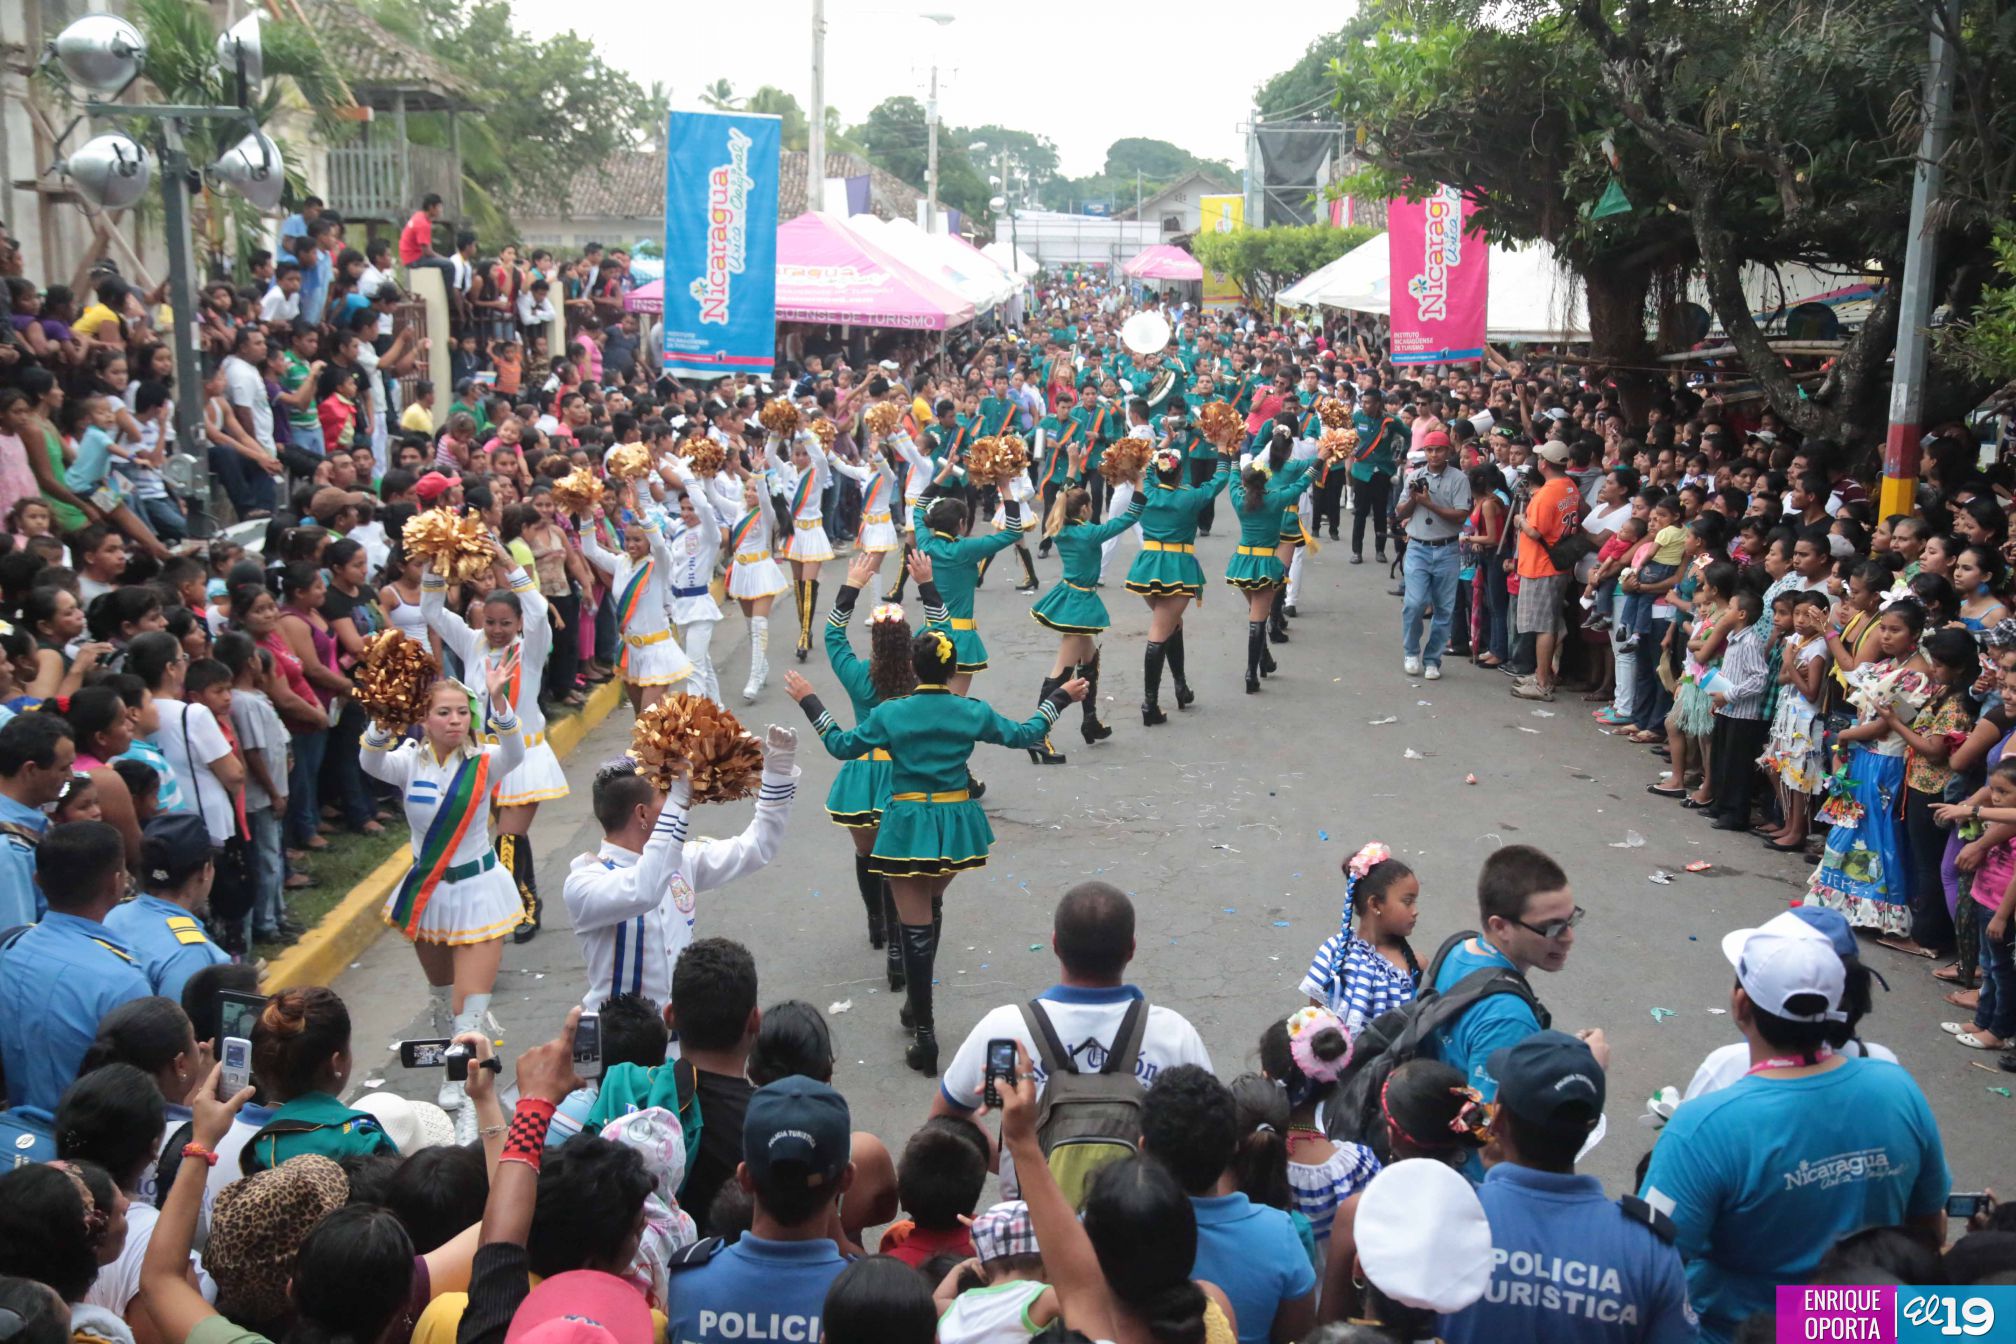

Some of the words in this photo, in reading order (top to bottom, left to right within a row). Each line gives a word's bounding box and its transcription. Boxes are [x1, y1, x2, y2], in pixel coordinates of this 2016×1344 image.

[703, 168, 733, 321] Nicaragua
[1421, 183, 1450, 317] Nicaragu
[841, 312, 864, 323] DE
[867, 312, 936, 328] TURISMO
[1783, 1153, 1889, 1191] Nicaragua
[1491, 1248, 1622, 1295] POLICIA
[1484, 1279, 1638, 1326] URISTICA
[699, 1309, 820, 1344] POLICI
